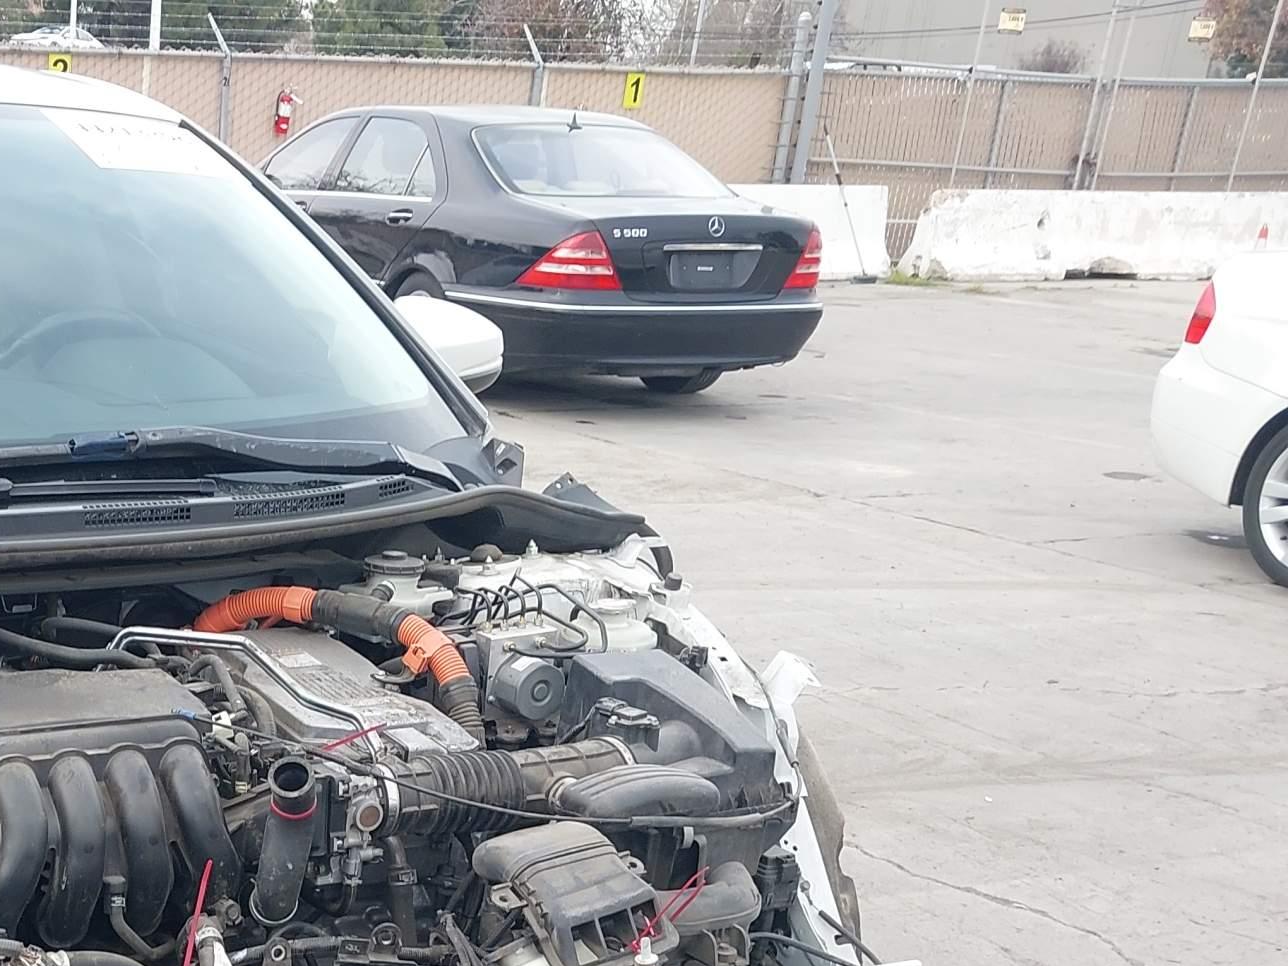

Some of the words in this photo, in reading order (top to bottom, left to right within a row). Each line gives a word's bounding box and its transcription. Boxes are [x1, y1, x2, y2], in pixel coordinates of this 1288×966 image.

[631, 77, 640, 103] 1
[613, 228, 621, 238] S
[623, 228, 648, 238] 500
